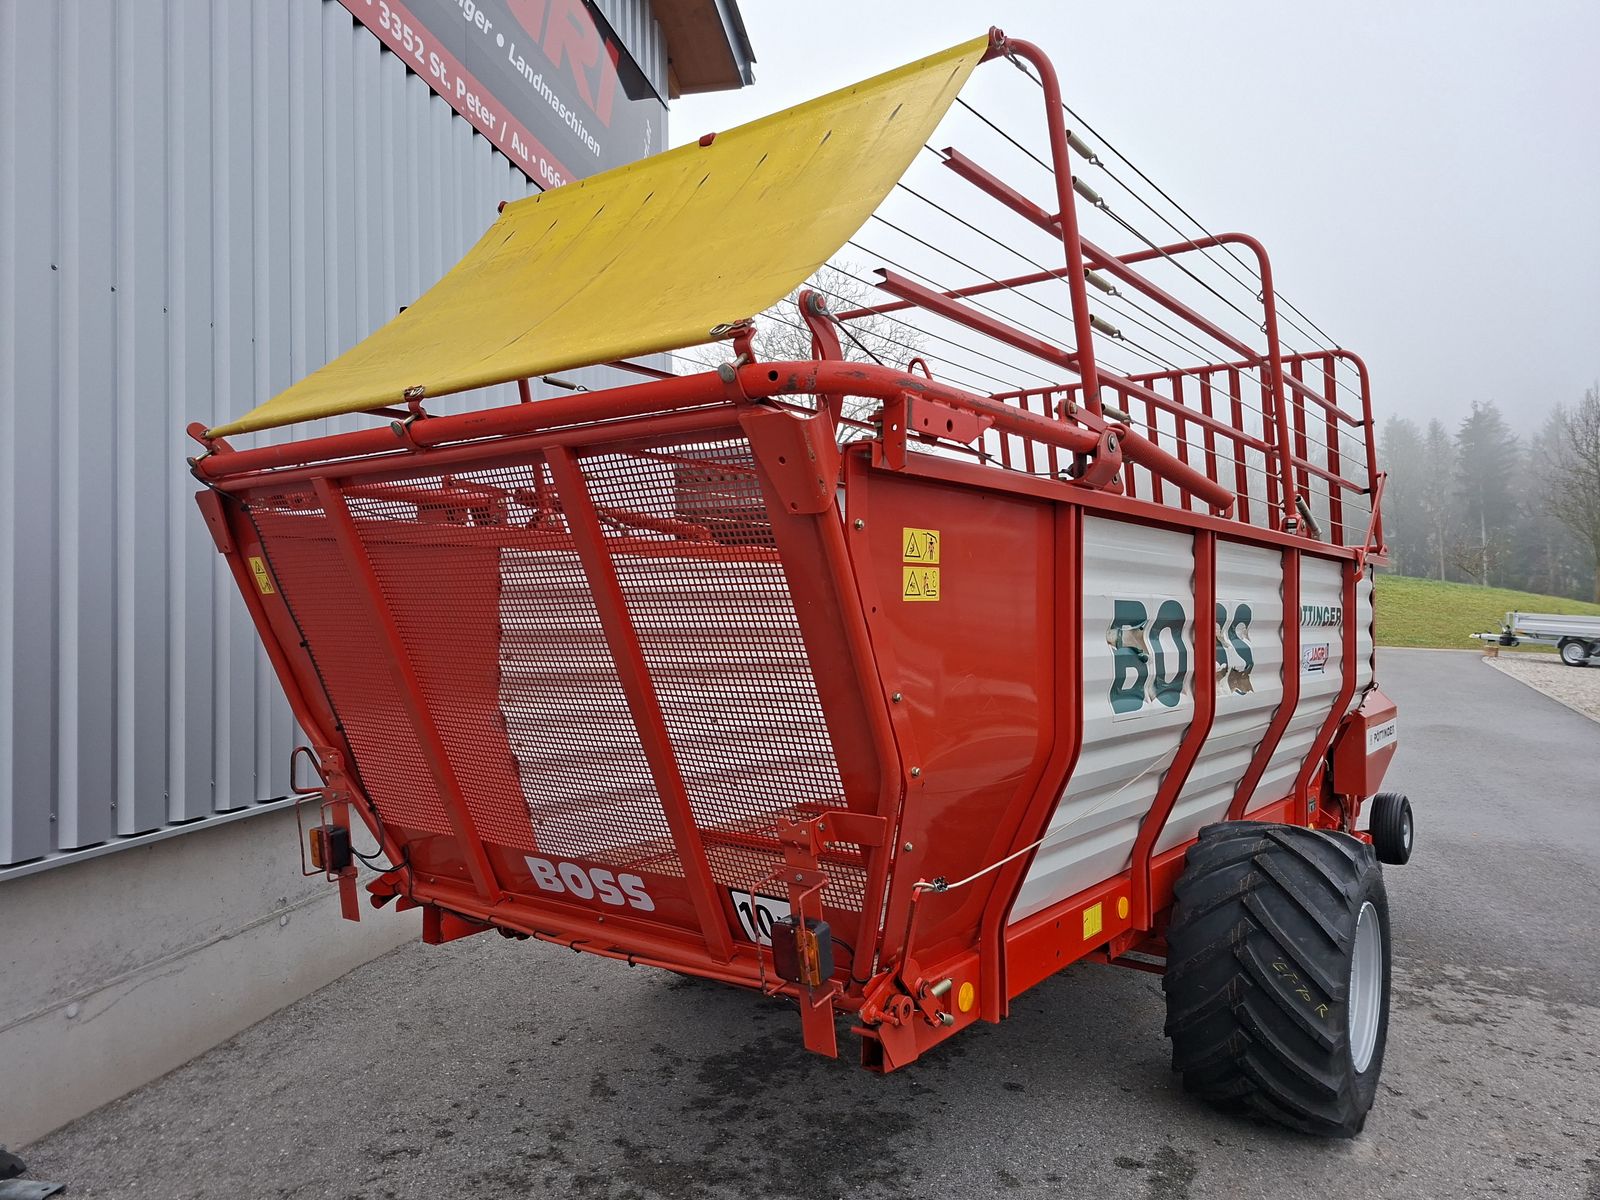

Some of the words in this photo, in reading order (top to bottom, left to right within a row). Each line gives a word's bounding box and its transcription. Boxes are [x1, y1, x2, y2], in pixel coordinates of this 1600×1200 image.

[379, 2, 425, 64] 3352
[429, 52, 451, 90] St.
[456, 76, 496, 129] Peter
[511, 131, 528, 162] Au
[508, 42, 600, 158] Landmaschinen
[1300, 605, 1342, 627] TTINGER
[523, 855, 656, 912] BOSS
